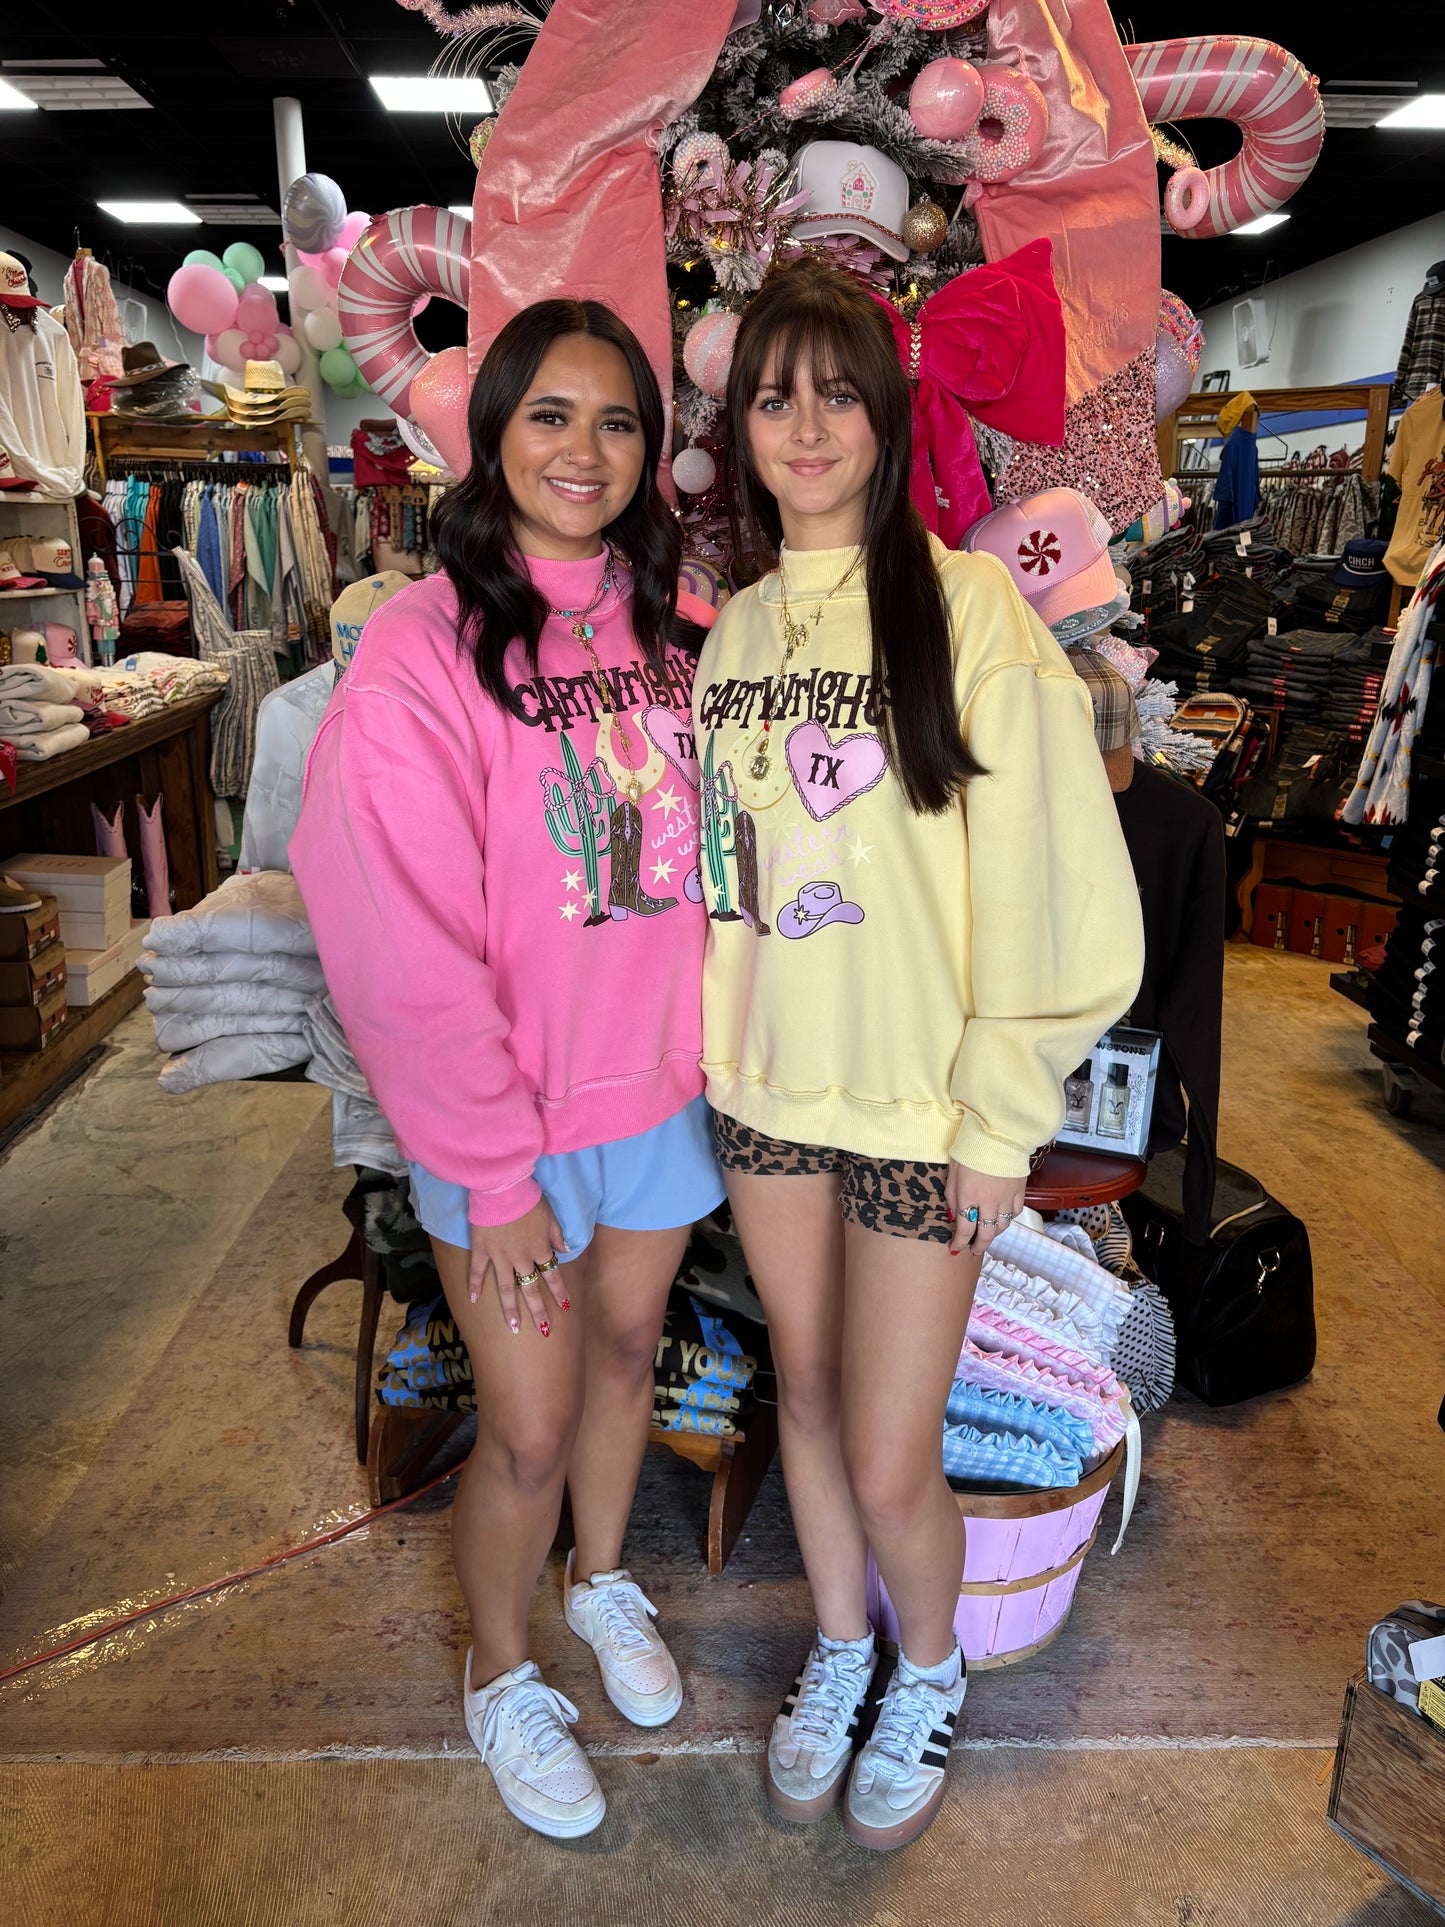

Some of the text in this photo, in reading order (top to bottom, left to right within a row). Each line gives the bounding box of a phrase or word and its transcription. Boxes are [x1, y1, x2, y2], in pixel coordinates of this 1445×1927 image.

[1348, 555, 1375, 567] CINCH
[340, 639, 358, 661] H
[673, 731, 698, 760] TX
[808, 752, 844, 790] TX
[651, 796, 700, 849] weste
[677, 831, 701, 856] we
[763, 823, 854, 872] western
[779, 848, 844, 887] wear
[1094, 1042, 1147, 1056] WSTONE
[395, 1319, 457, 1352] OUN
[679, 1340, 758, 1388] YOUR
